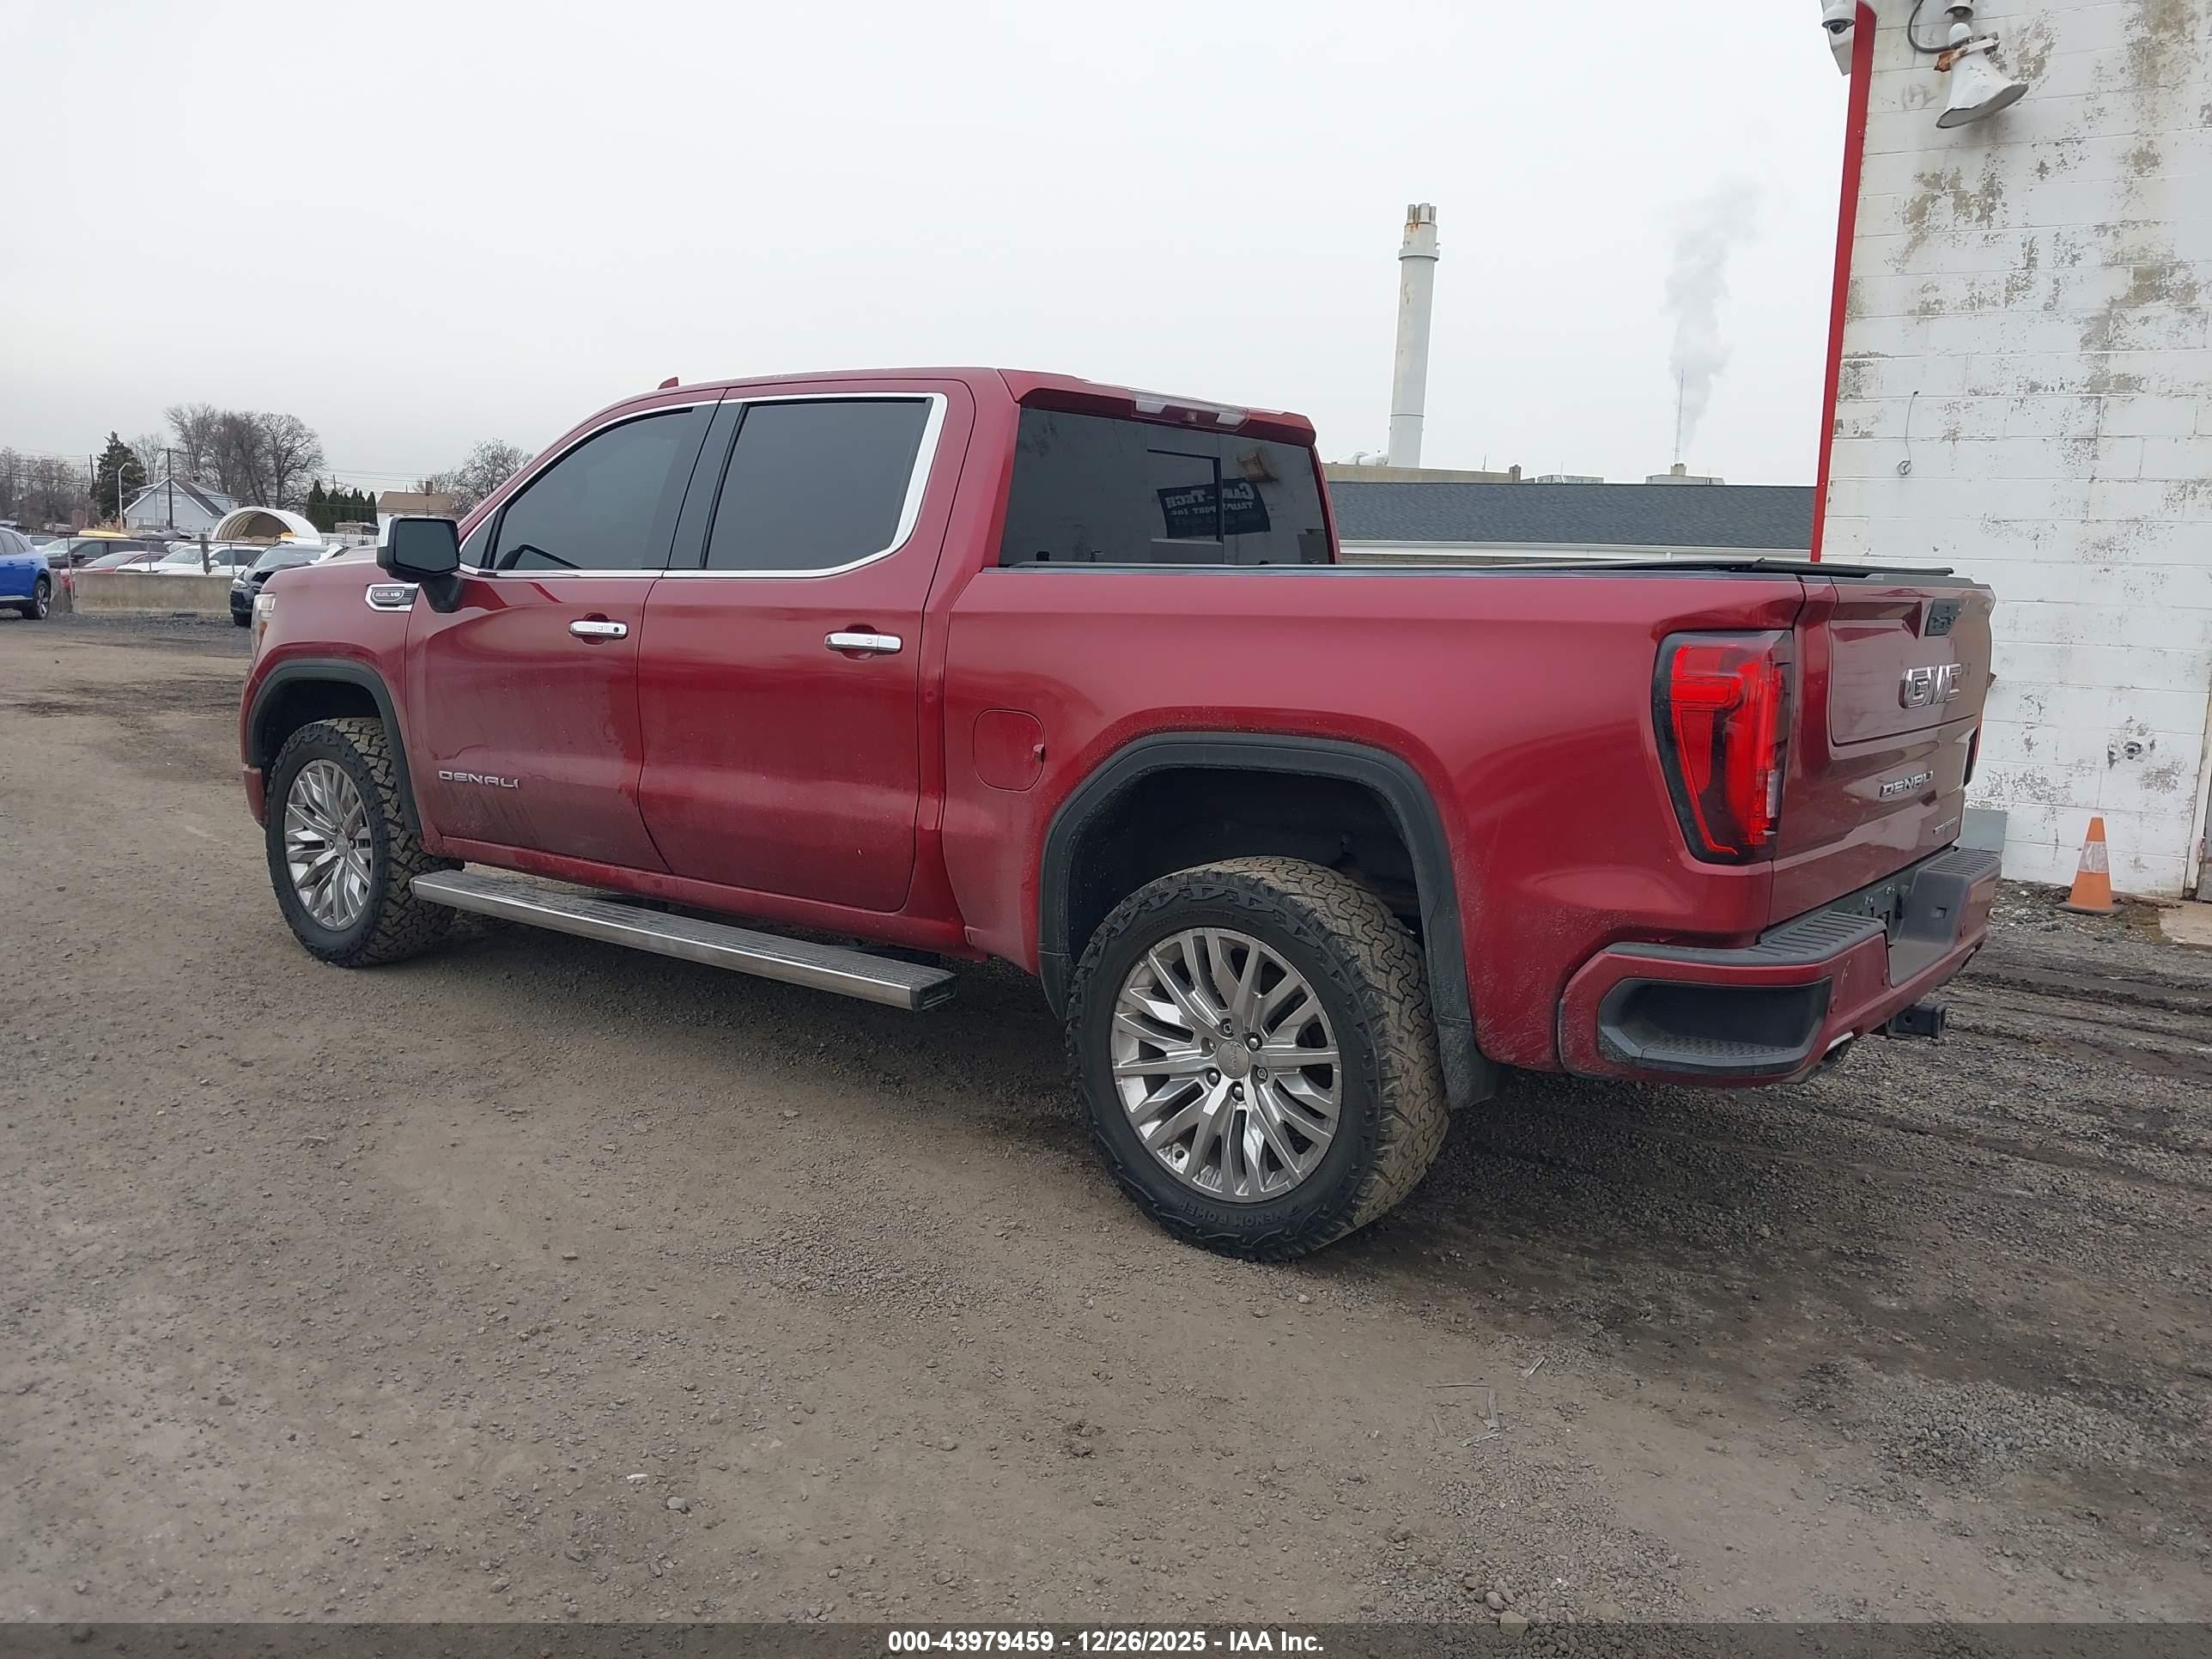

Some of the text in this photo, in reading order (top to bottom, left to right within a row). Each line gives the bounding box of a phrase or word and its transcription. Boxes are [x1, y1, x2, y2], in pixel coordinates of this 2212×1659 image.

[1901, 663, 1963, 708] GMC
[438, 769, 520, 790] DENALI
[1879, 769, 1934, 798] DENALI
